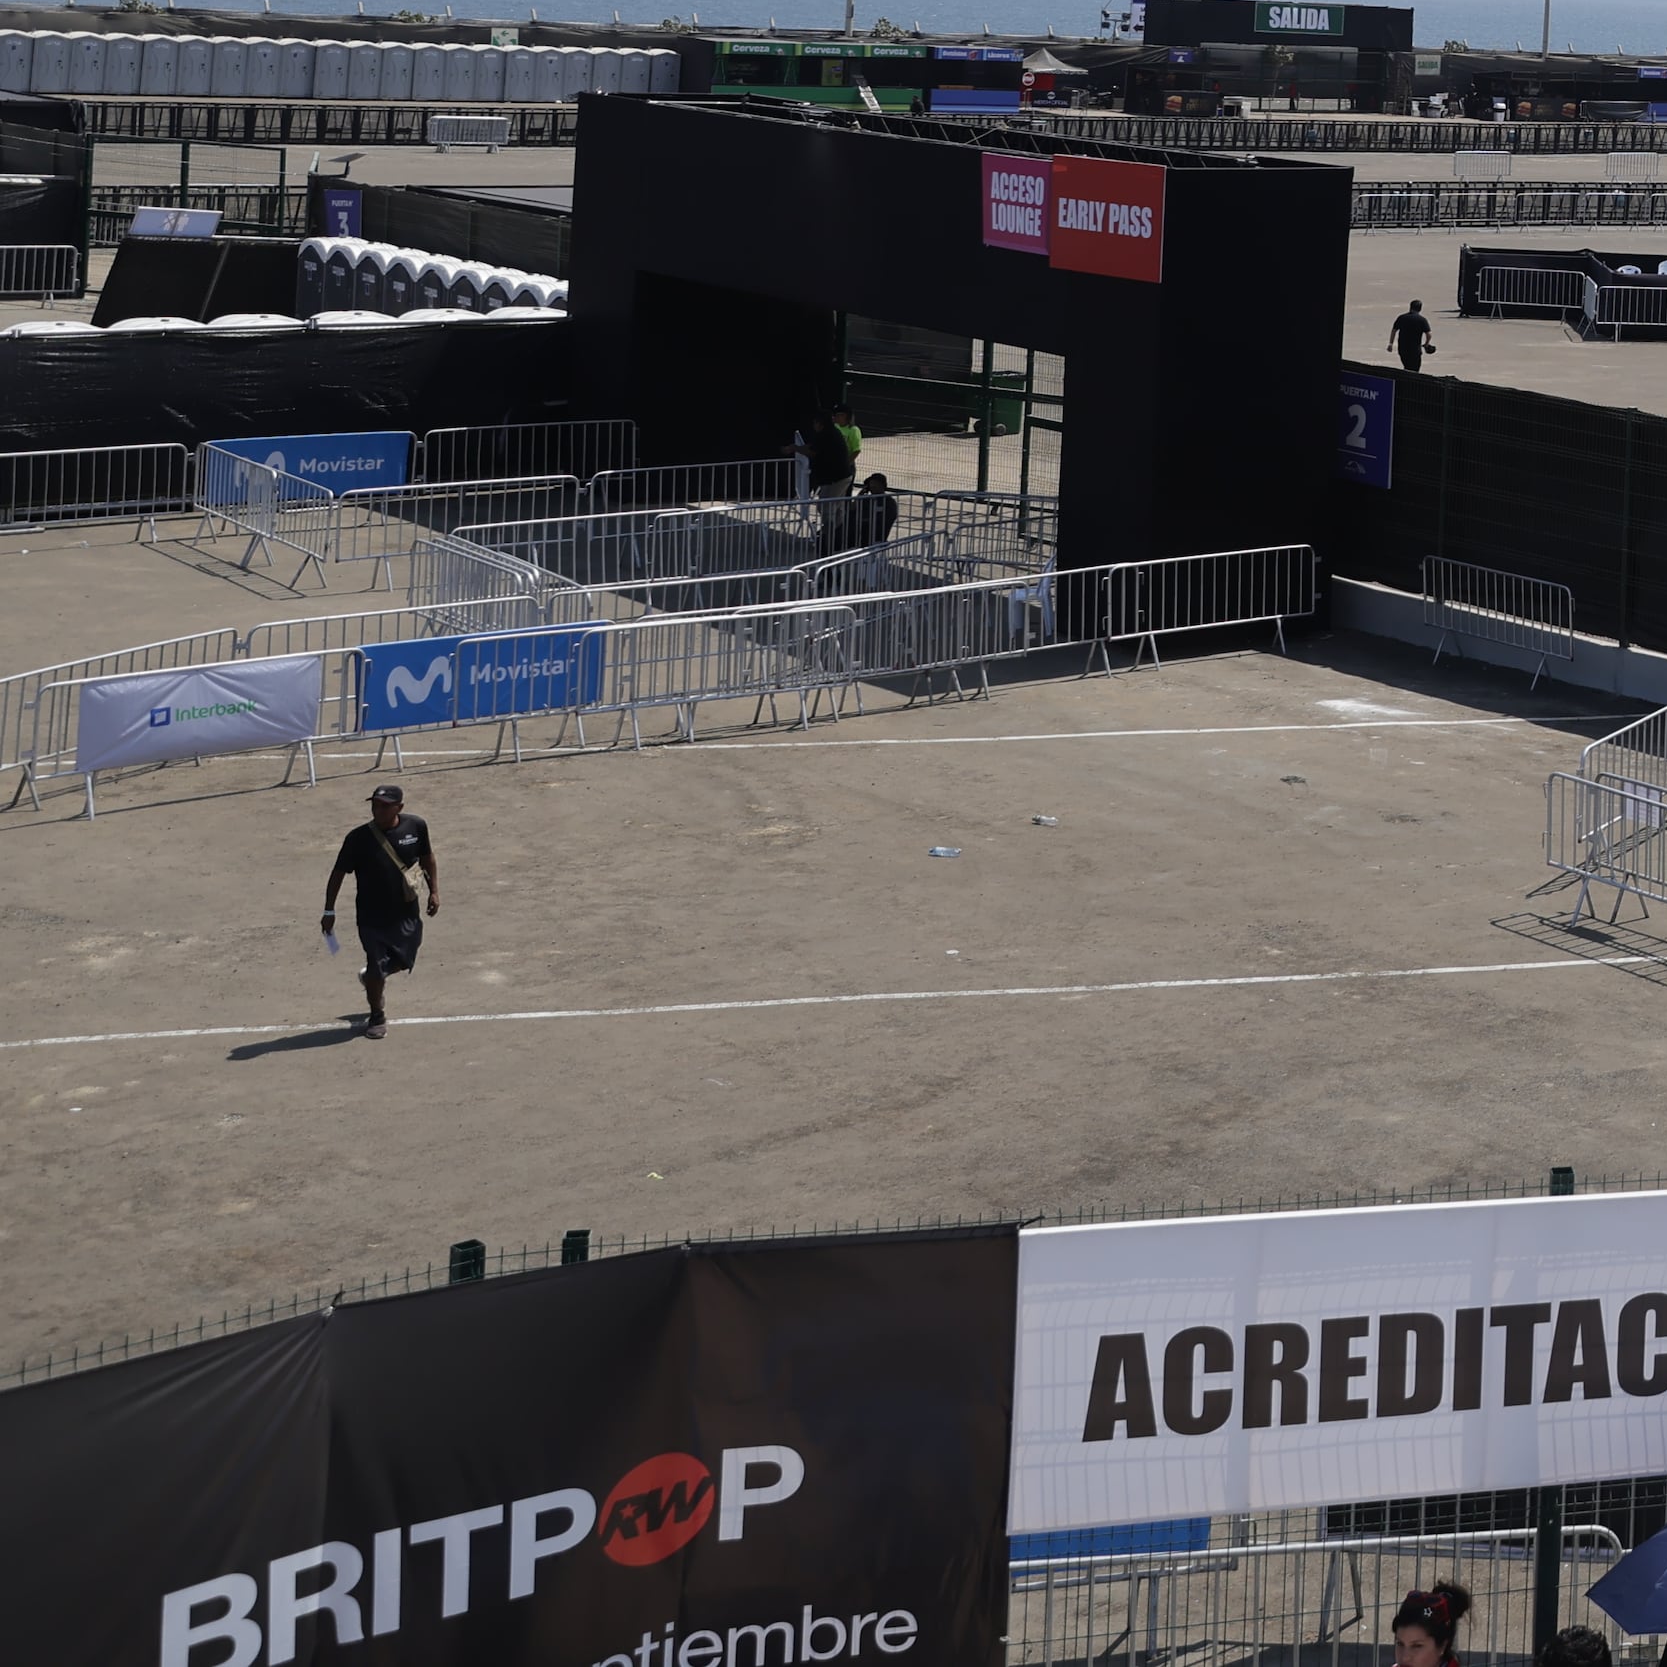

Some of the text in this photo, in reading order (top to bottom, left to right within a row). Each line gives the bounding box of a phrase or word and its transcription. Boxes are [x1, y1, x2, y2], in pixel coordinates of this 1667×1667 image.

[1269, 6, 1330, 31] SALIDA
[732, 44, 770, 53] Cerveza
[804, 46, 841, 55] Cerveza
[873, 48, 909, 56] Cerveza
[991, 171, 1044, 206] ACCESO
[337, 212, 349, 237] 3
[992, 202, 1042, 237] LOUNGE
[1058, 197, 1152, 239] EARLY PASS
[1346, 404, 1367, 449] 2
[300, 456, 385, 474] Movistar
[469, 658, 575, 685] Movistar
[174, 699, 259, 723] Interbank
